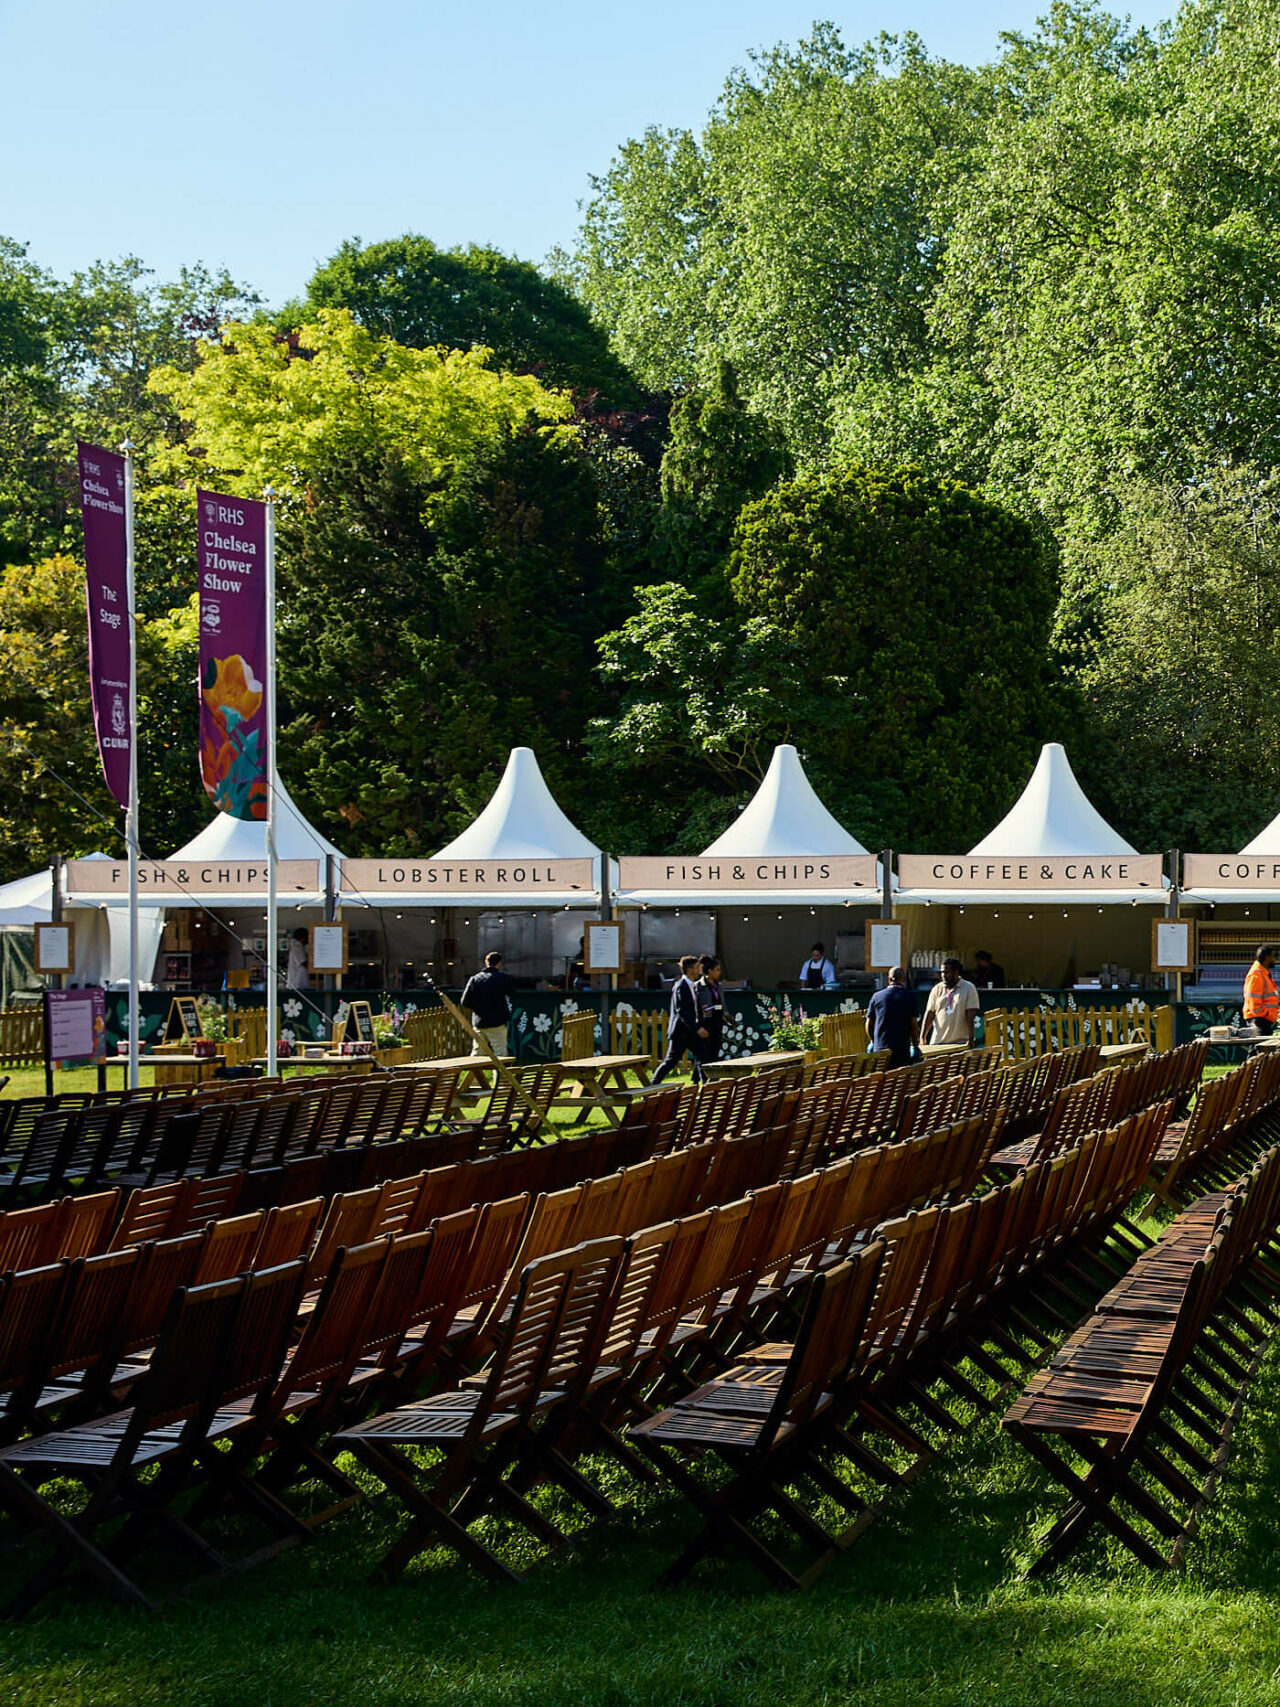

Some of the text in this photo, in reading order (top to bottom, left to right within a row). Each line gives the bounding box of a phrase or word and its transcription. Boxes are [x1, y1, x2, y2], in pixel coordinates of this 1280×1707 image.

[218, 506, 245, 526] RHS
[204, 531, 256, 554] Chelsea
[205, 552, 252, 574] Flower
[203, 573, 242, 593] Show
[102, 585, 117, 602] The
[100, 608, 121, 629] Stage
[112, 869, 165, 883] FSH
[177, 869, 190, 883] &
[378, 867, 556, 883] LOBSTER ROLL
[666, 864, 830, 880] FISH & CHIPS
[932, 864, 1129, 880] COFFEE & CAKE
